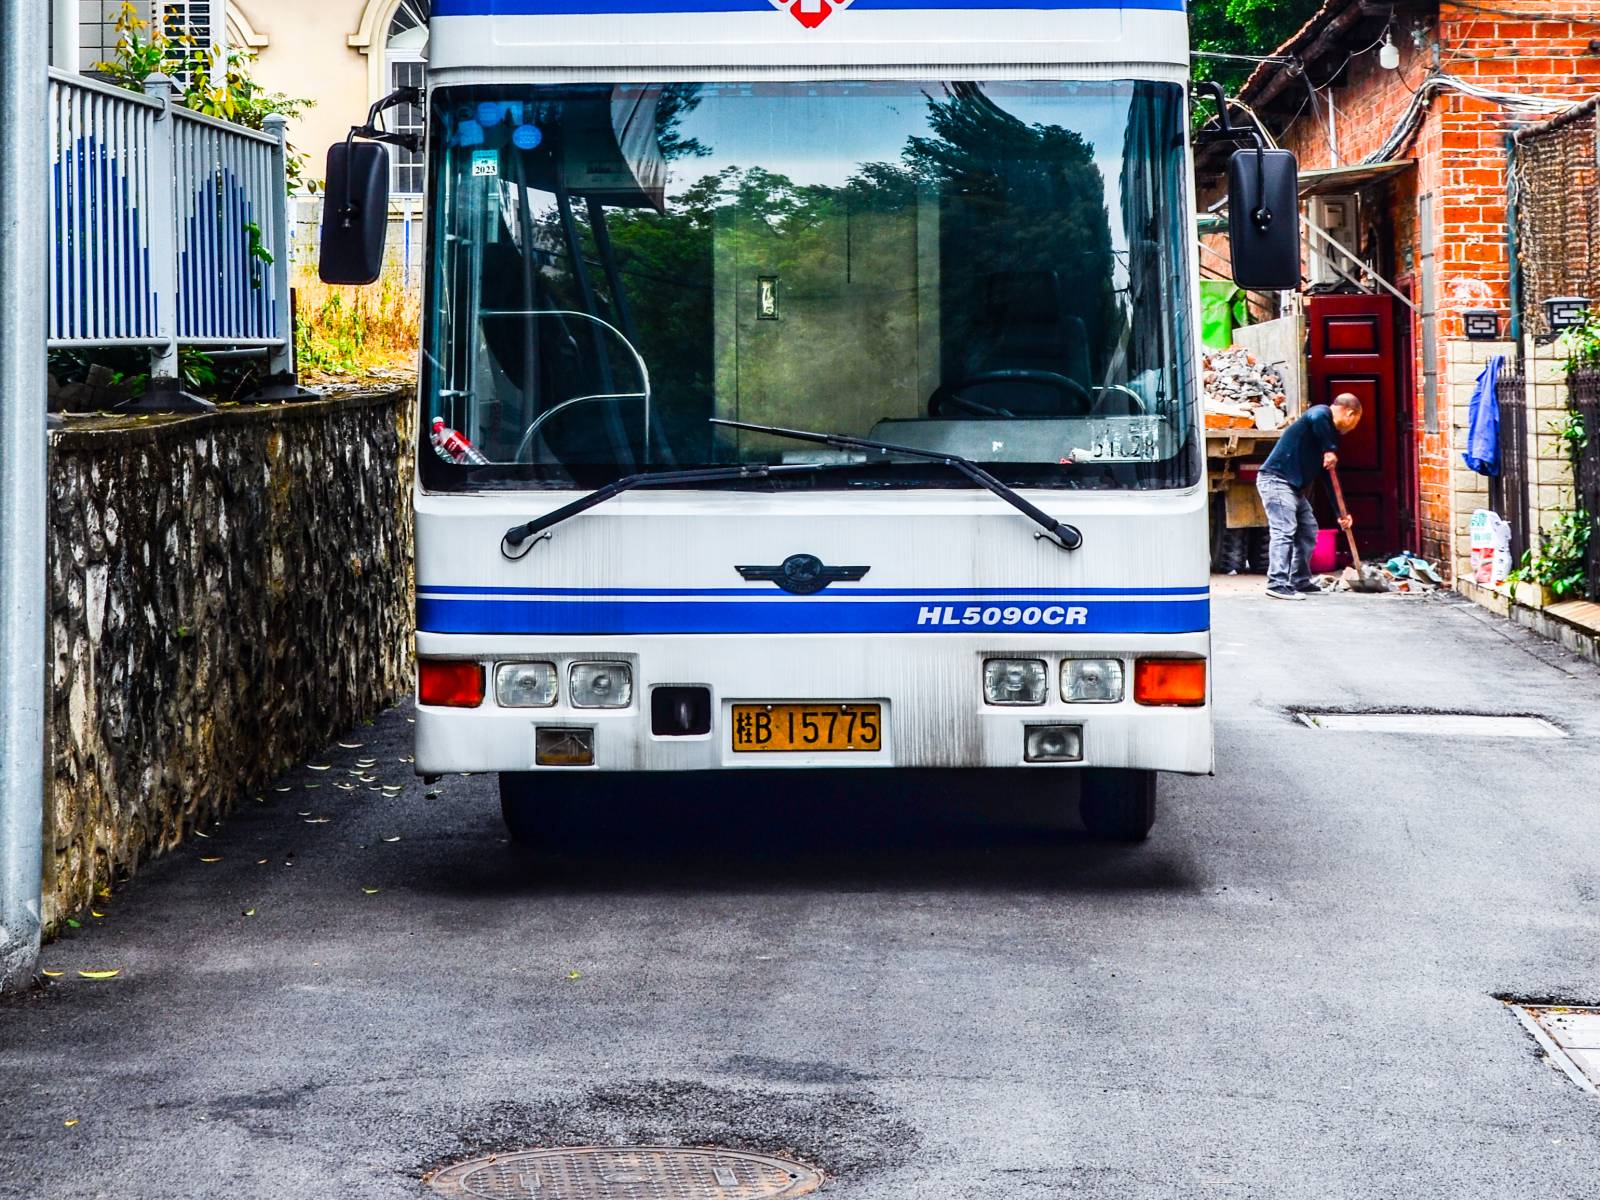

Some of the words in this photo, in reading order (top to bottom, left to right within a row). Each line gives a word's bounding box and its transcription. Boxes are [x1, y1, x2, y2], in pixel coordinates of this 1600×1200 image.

[475, 165, 496, 174] 2023
[917, 606, 1088, 625] HL5090CR
[788, 711, 877, 744] 15775
